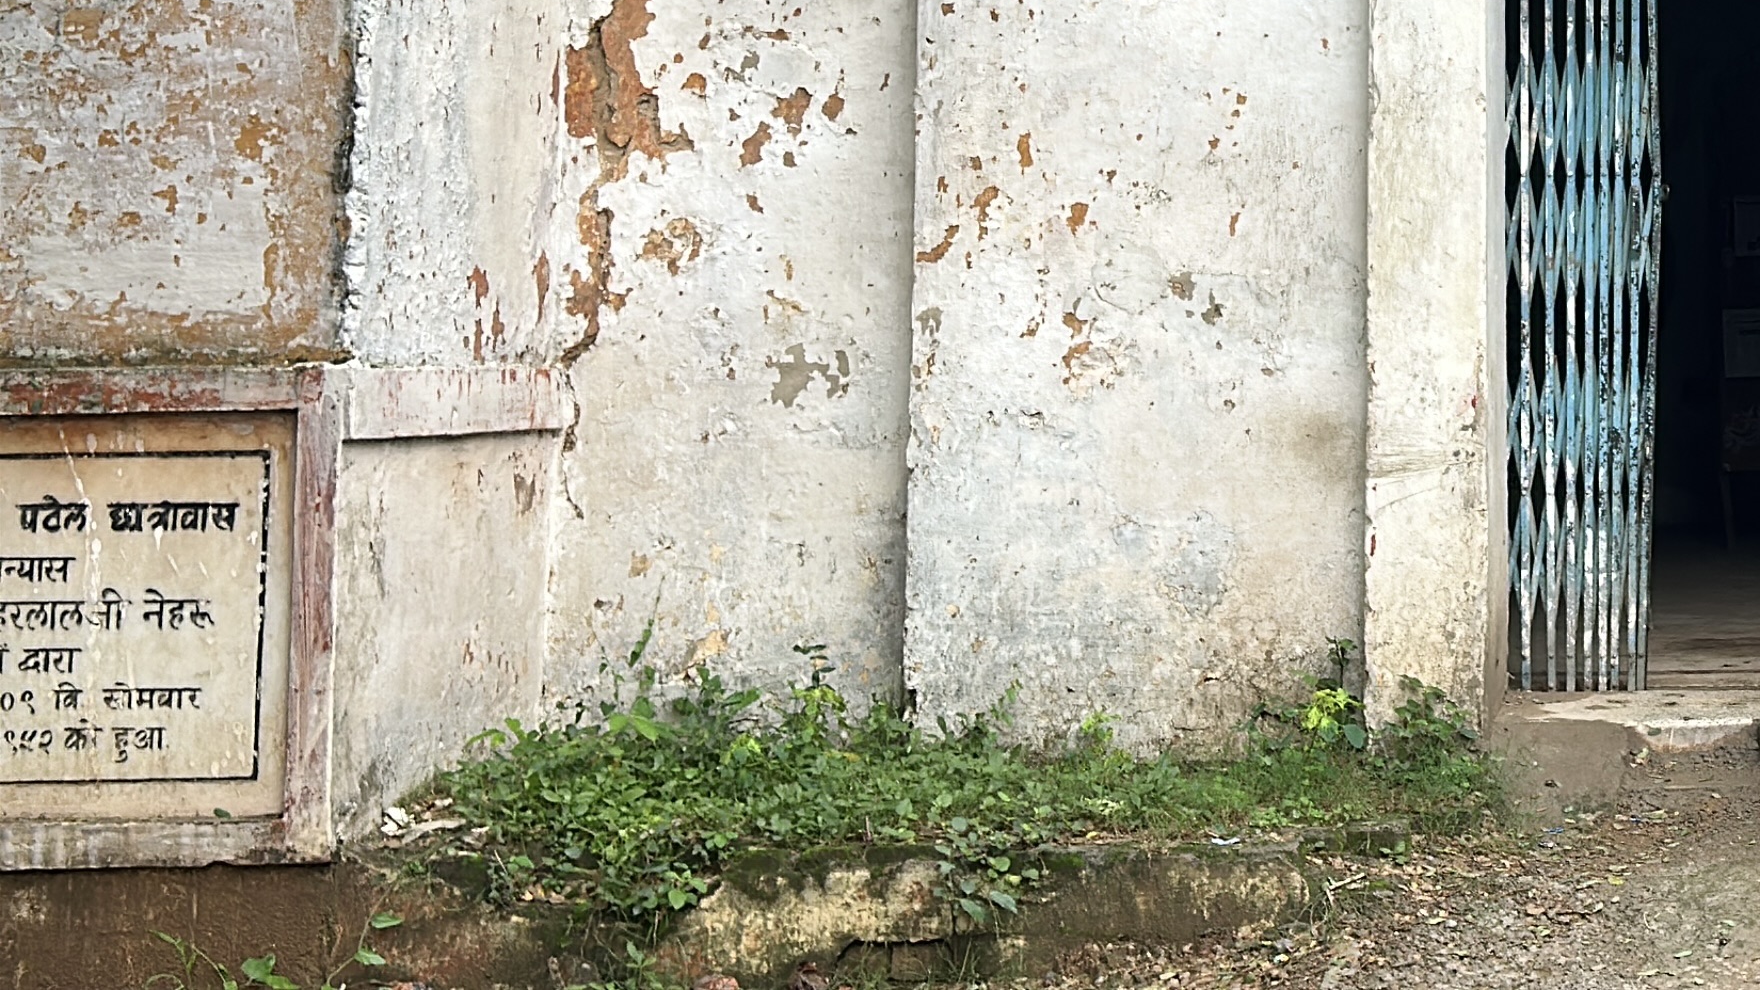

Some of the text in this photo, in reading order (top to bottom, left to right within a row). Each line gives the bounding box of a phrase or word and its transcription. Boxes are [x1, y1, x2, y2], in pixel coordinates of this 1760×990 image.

[16, 495, 88, 533] पटेल
[0, 556, 76, 583] न्यास
[143, 588, 215, 631] नेहरू
[102, 682, 201, 710] सोमवार
